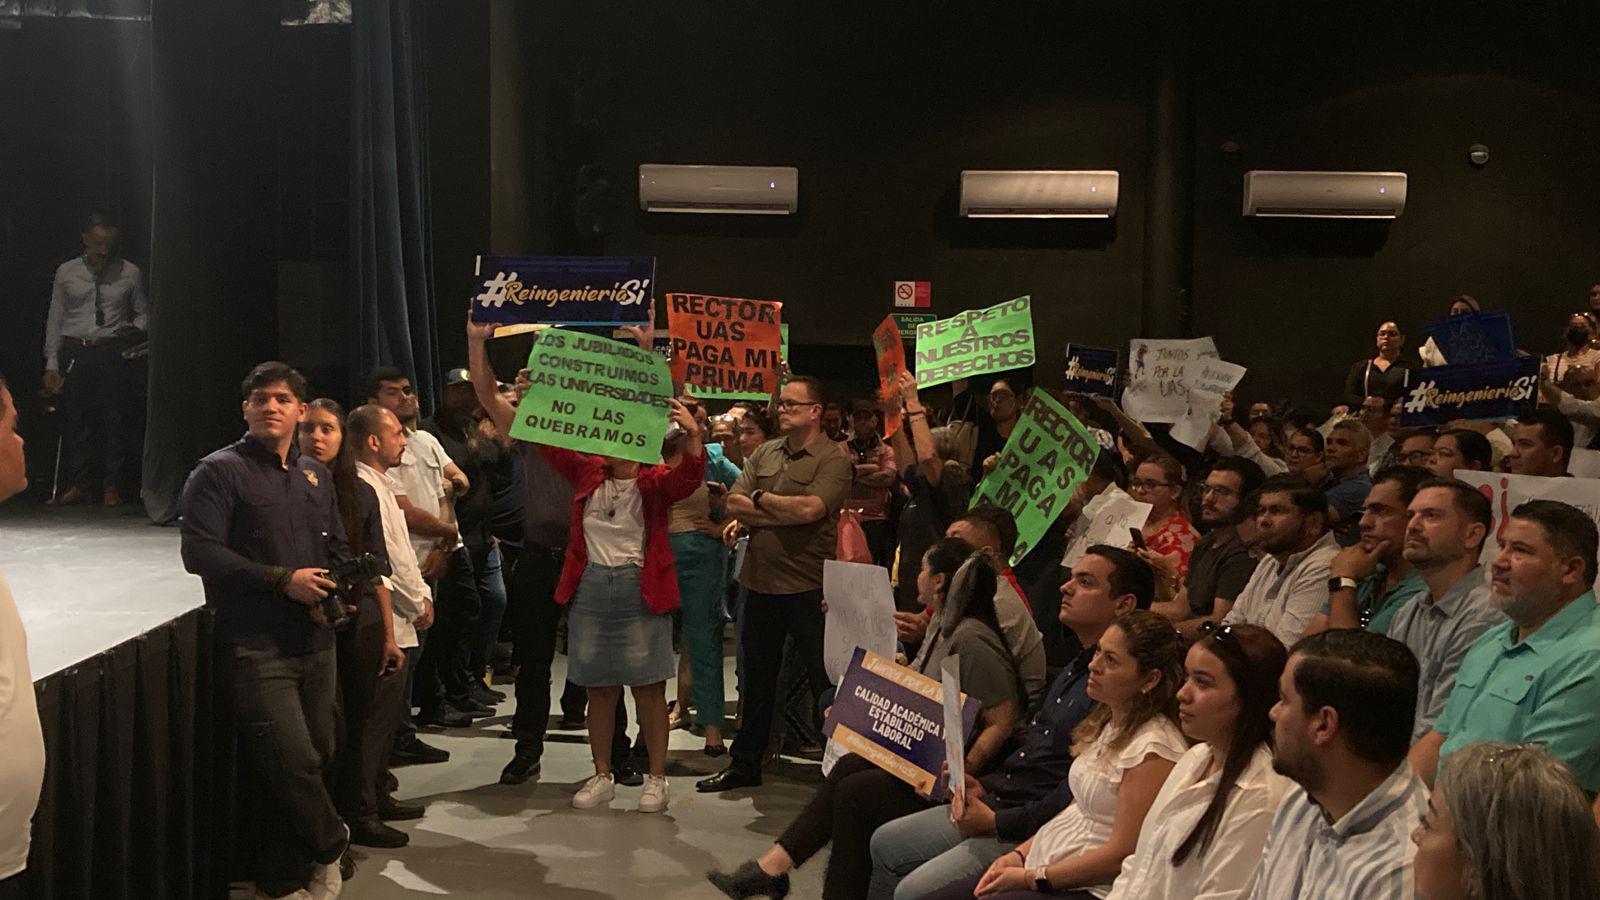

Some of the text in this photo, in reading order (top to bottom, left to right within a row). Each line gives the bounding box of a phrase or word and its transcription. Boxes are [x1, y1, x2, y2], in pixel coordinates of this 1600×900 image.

[672, 294, 775, 325] RECTOR
[918, 298, 1029, 340] RESPETO
[696, 319, 746, 342] UAS
[917, 328, 1030, 366] NUESTROS
[960, 327, 979, 340] A
[538, 334, 566, 349] LOS
[572, 337, 655, 366] JUBILADOS
[673, 337, 734, 367] PAGA
[745, 348, 777, 369] MI
[917, 349, 1034, 385] DERECHOS
[538, 352, 660, 386] CONSTRUIMOS
[685, 363, 763, 393] PRIMA
[1172, 365, 1184, 377] LA
[528, 371, 557, 386] LAS
[560, 376, 670, 408] UNIVERSIDADES
[551, 400, 625, 425] NO LAS
[525, 415, 647, 447] QUEBRAMOS
[1024, 395, 1096, 476] RECTOR
[1018, 427, 1076, 490] UAS
[996, 481, 1028, 520] MI
[1001, 448, 1057, 519] PAGA
[854, 685, 940, 737] CALIDAD ACADÉMICA
[868, 706, 925, 742] ESTABILIDAD
[872, 720, 913, 750] LABORAL
